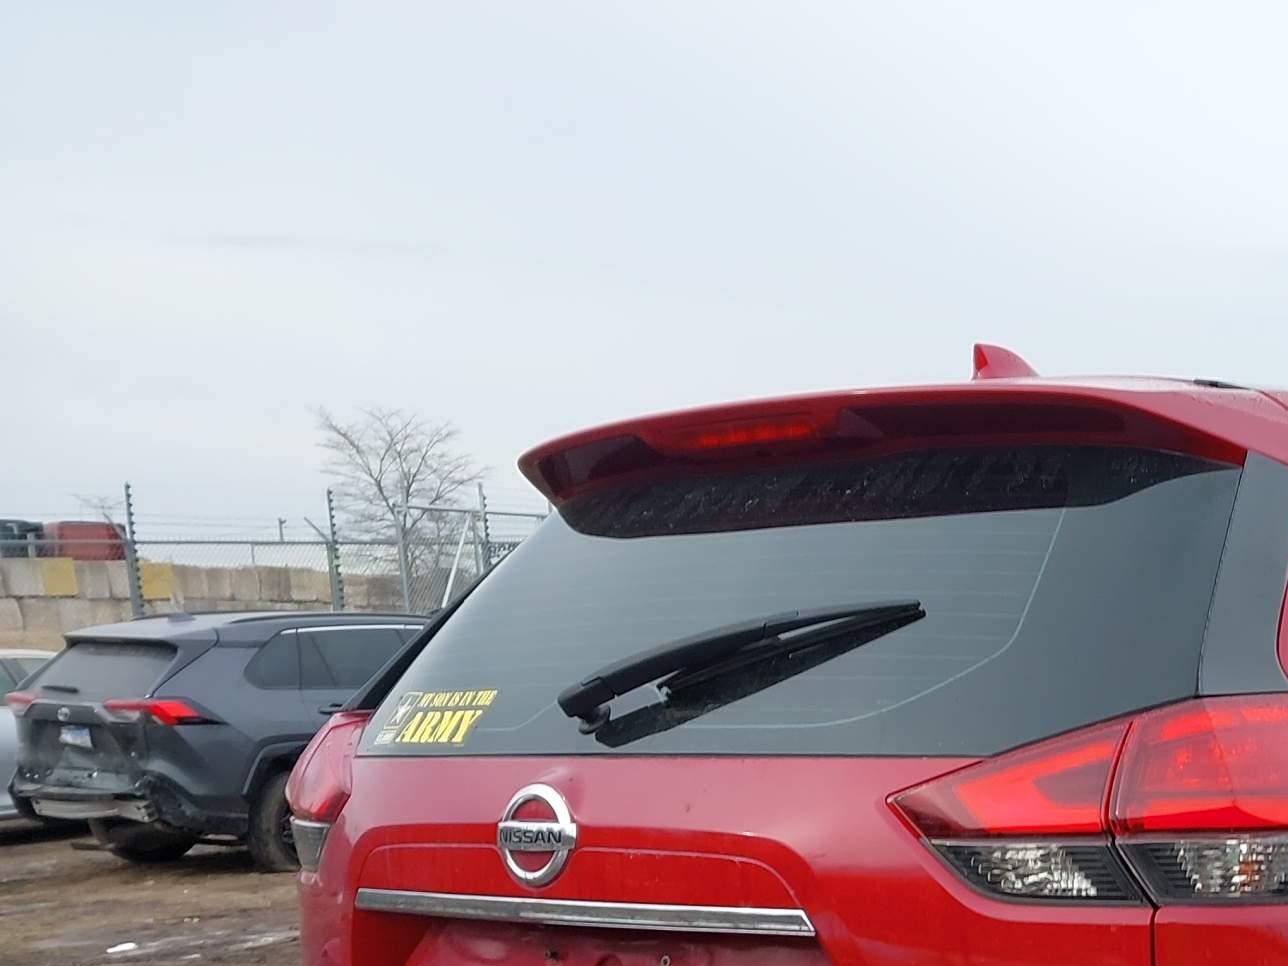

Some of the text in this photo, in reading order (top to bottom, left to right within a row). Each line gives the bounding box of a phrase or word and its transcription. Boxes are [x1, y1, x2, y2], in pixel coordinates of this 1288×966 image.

[472, 690, 498, 706] THE
[395, 709, 483, 743] ARMY
[499, 827, 562, 844] NISSAN
